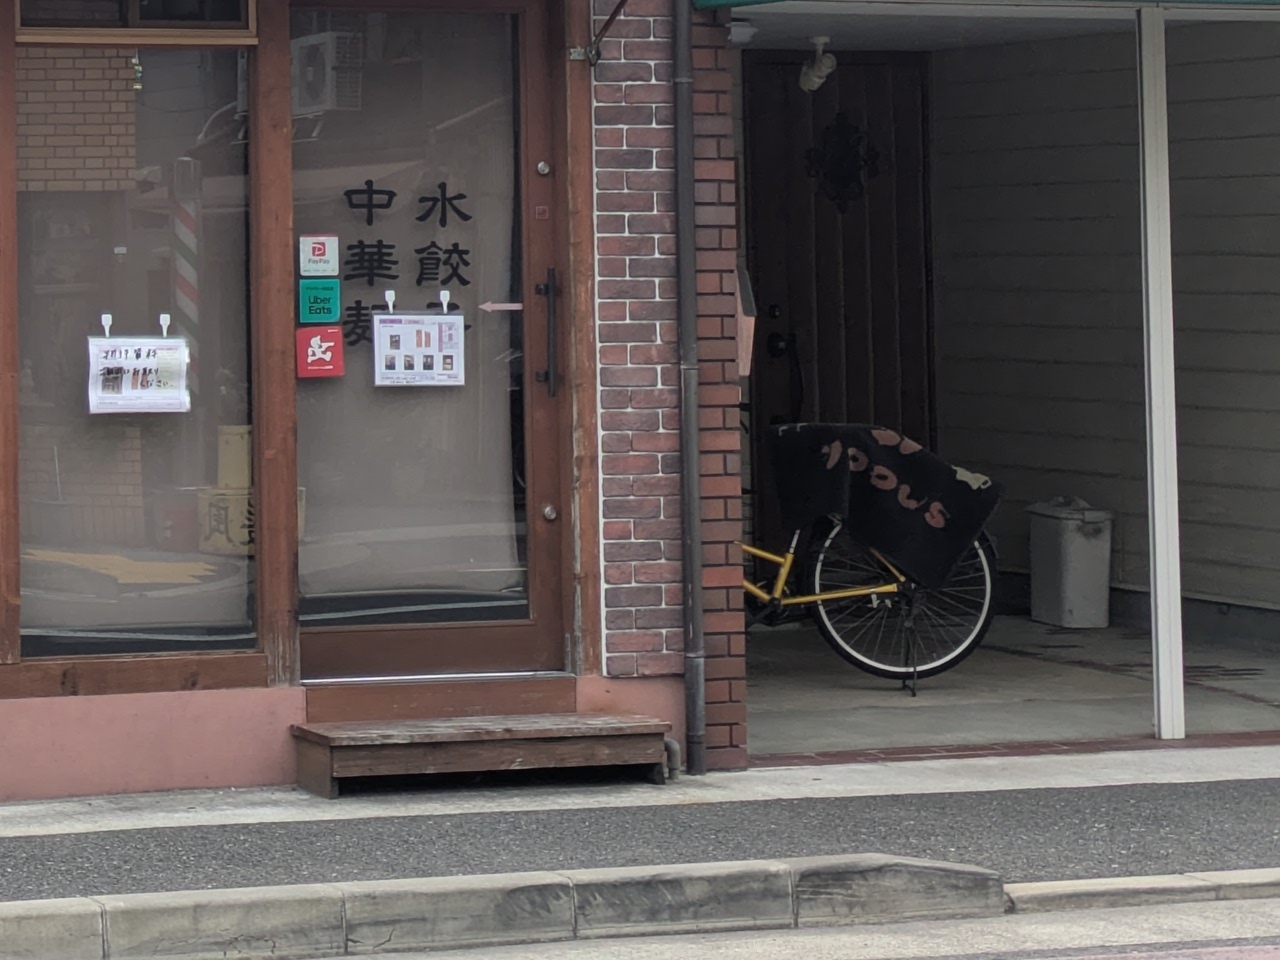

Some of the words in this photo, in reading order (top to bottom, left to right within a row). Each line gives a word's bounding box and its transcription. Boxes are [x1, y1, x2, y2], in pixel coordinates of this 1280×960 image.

[414, 181, 474, 333] 水餃
[308, 295, 332, 305] Uber
[308, 305, 333, 315] Eats
